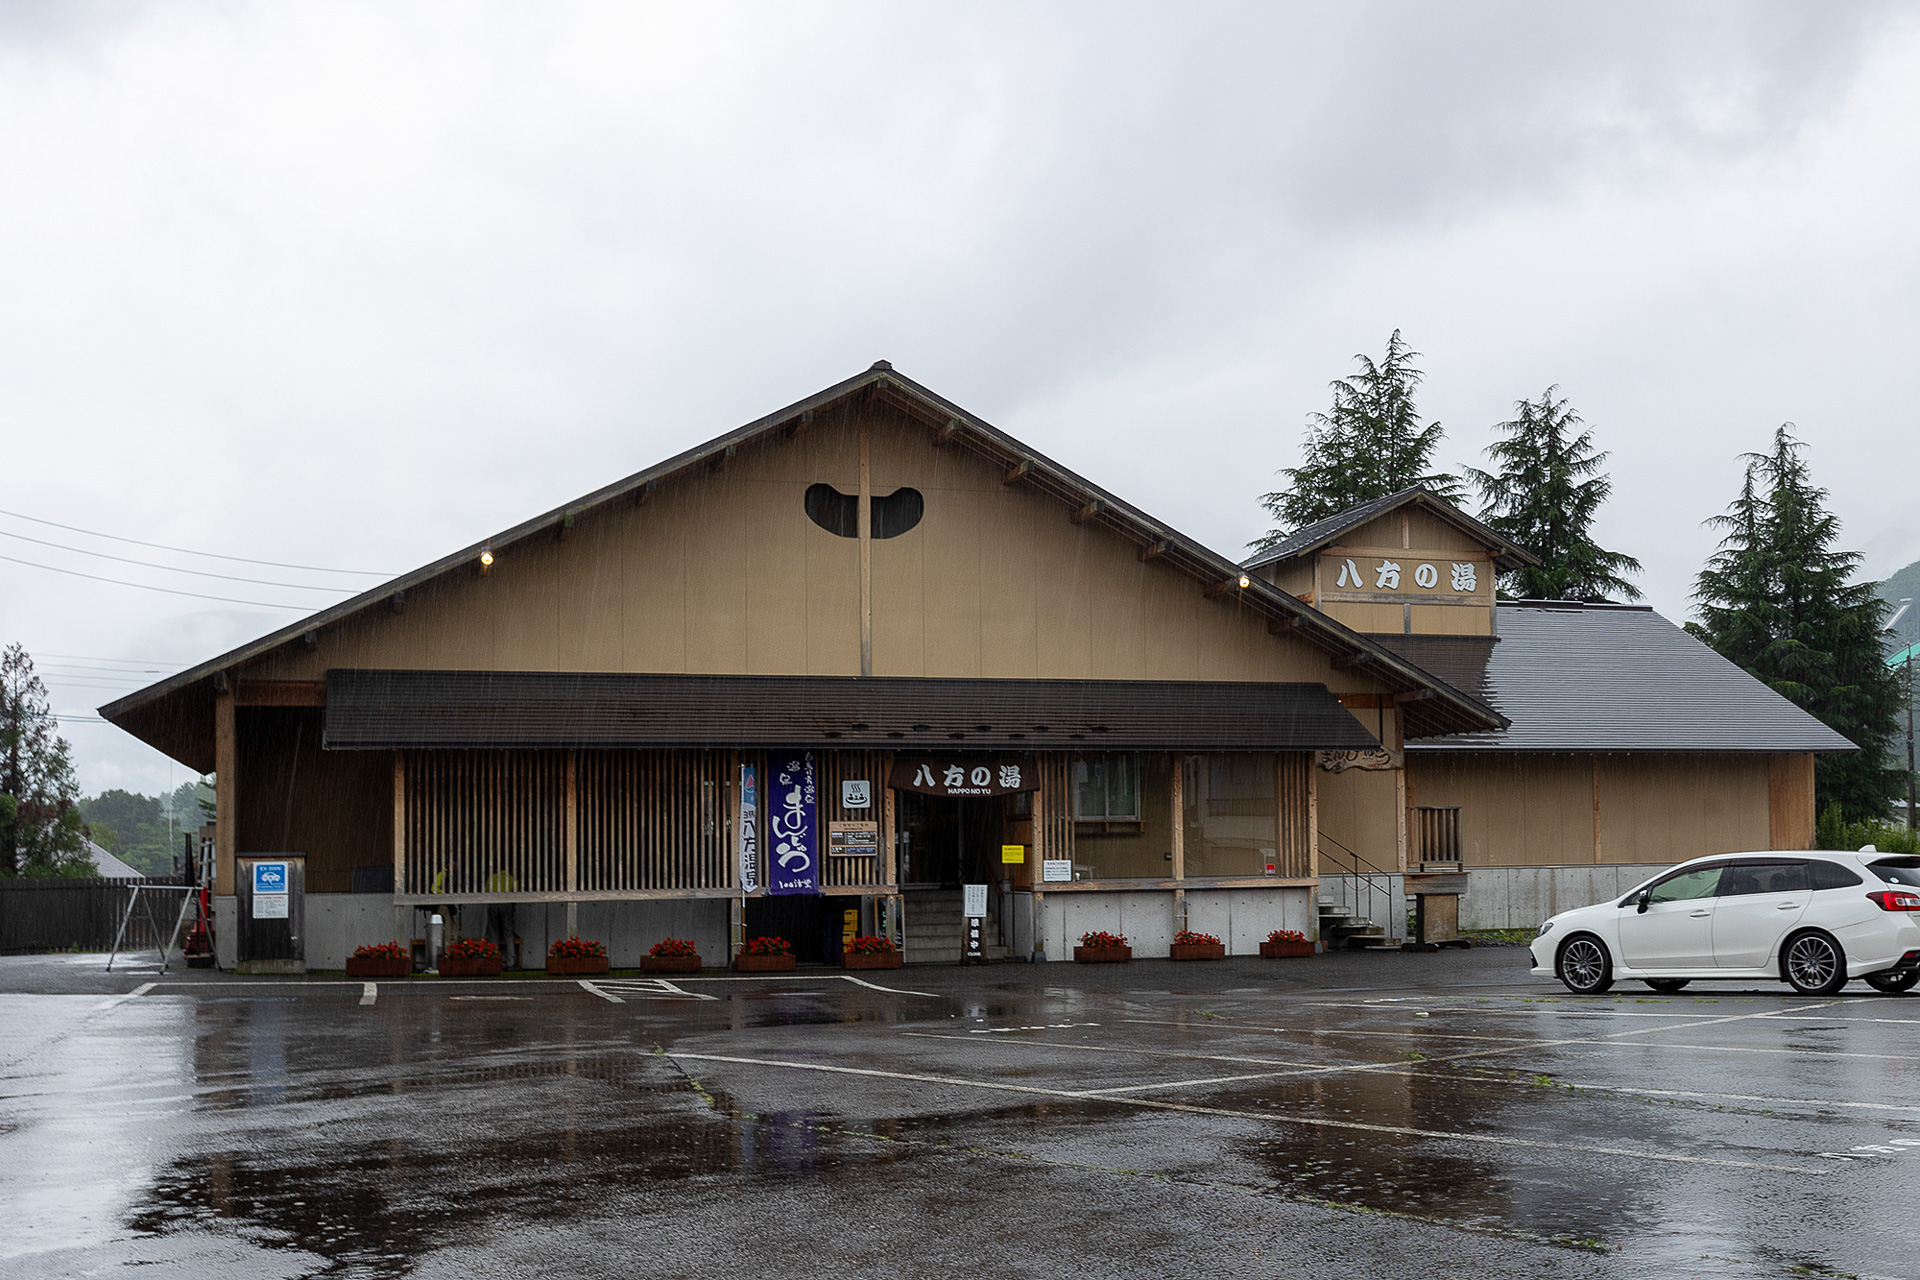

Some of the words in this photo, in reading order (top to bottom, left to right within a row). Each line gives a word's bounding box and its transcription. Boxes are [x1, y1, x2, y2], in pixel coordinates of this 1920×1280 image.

[1336, 558, 1477, 592] 八方の湯
[913, 763, 1022, 789] 八方の湯
[947, 787, 970, 795] HAPPO
[970, 787, 981, 795] NO
[981, 787, 992, 795] YU
